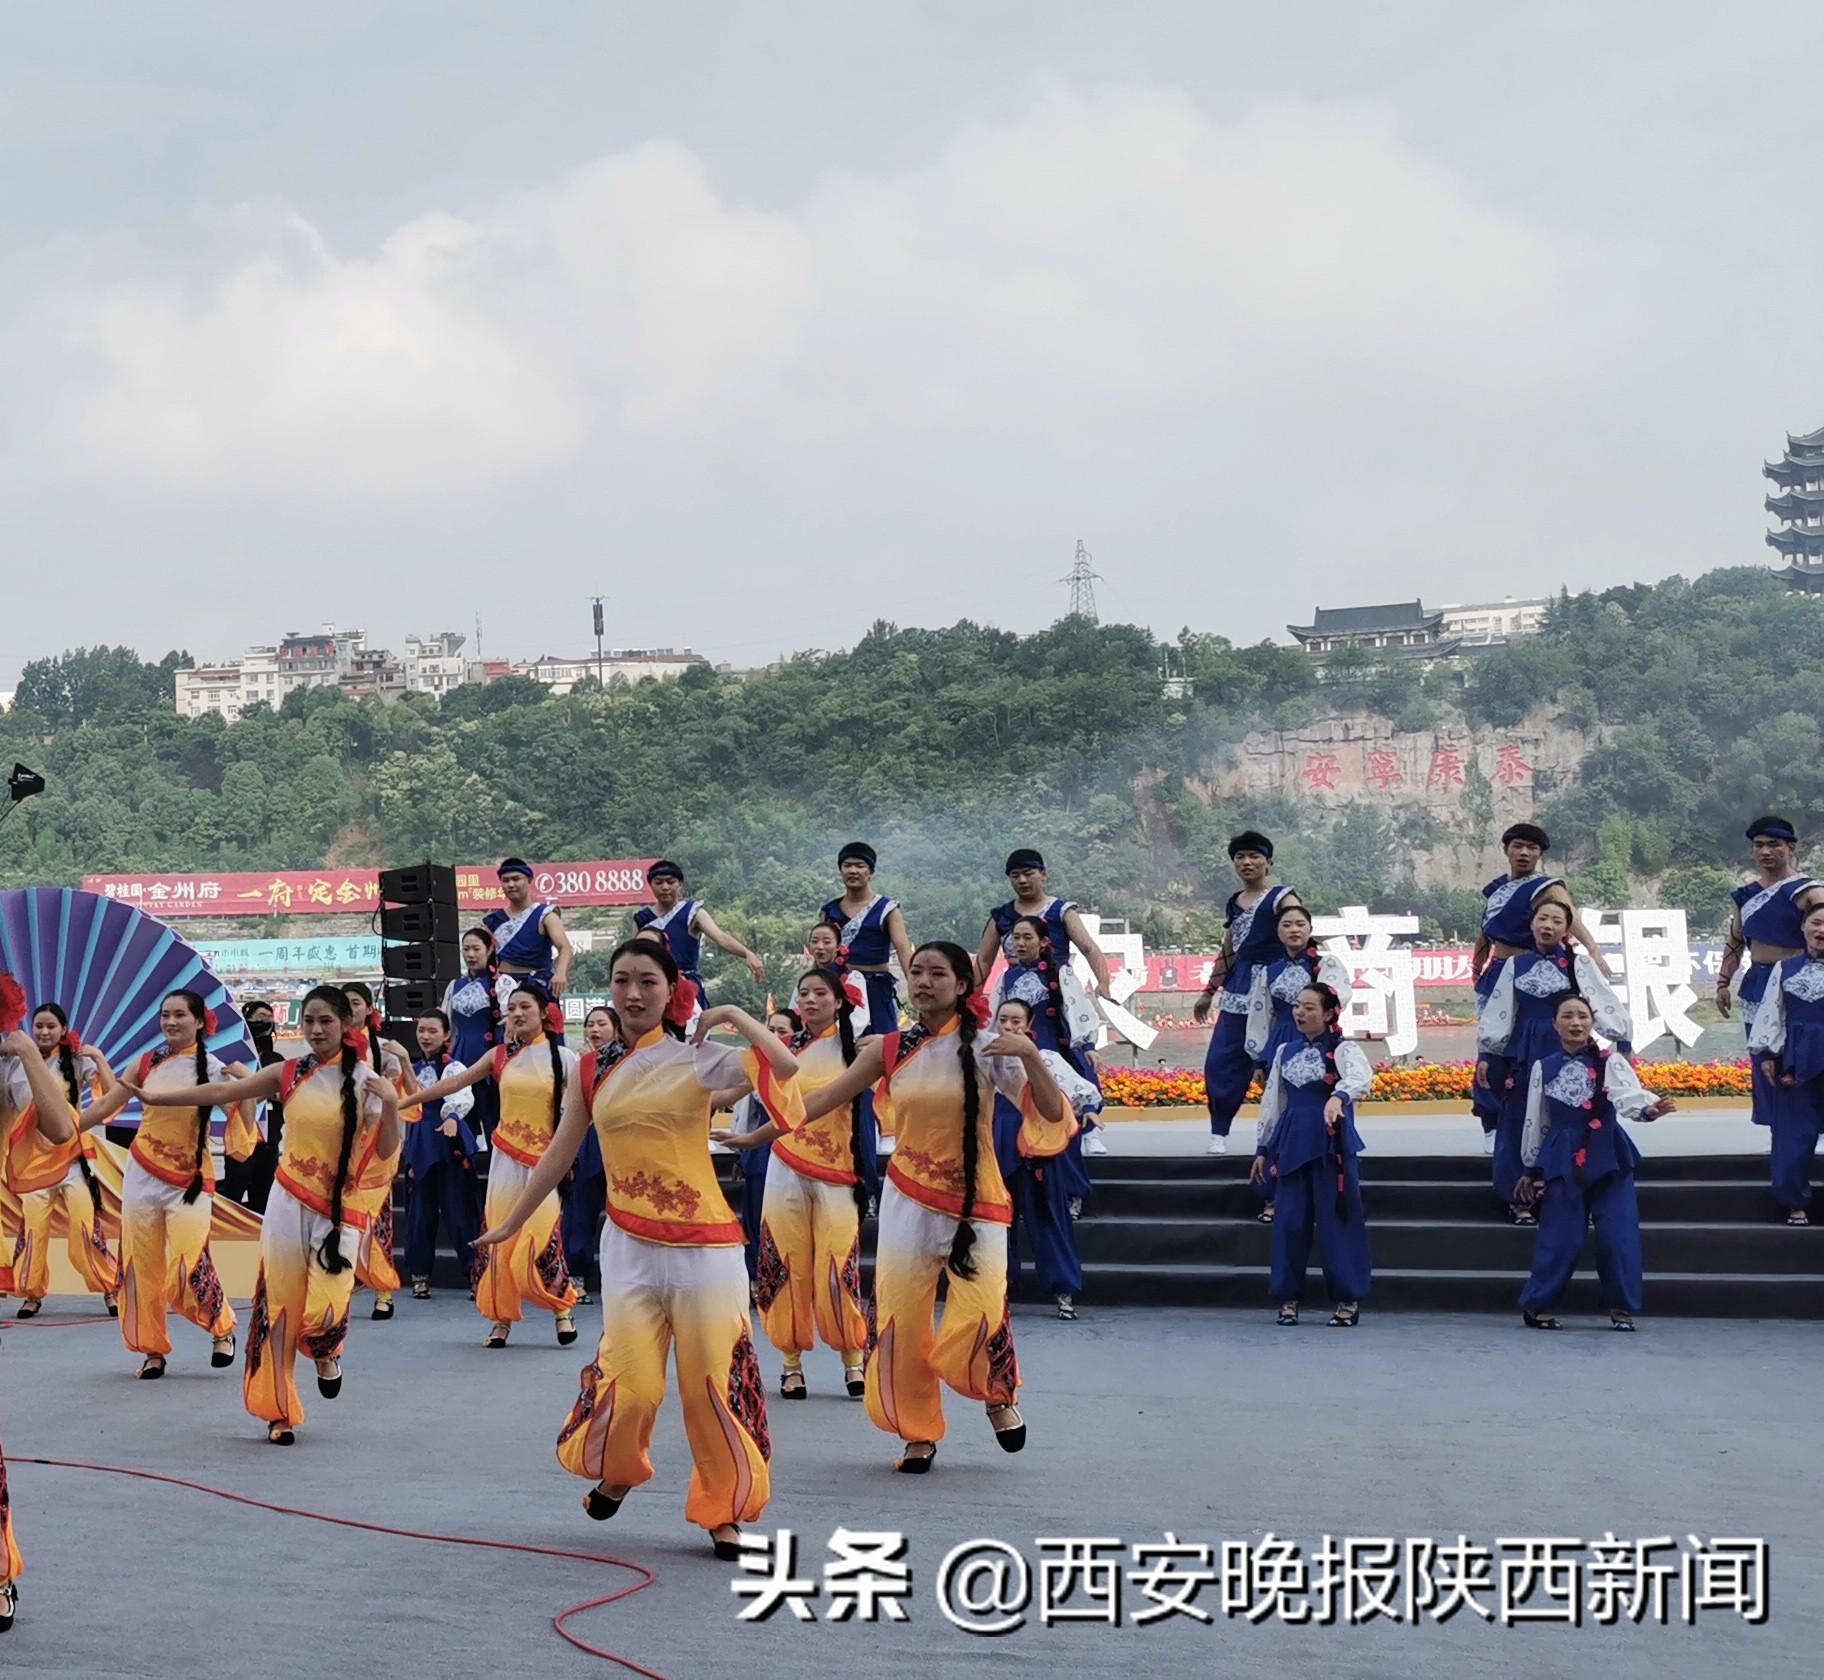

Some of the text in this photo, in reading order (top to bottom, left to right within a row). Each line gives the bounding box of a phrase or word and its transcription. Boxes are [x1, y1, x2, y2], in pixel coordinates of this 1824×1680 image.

[555, 868, 644, 894] 380 8888
[346, 943, 380, 961] 首期
